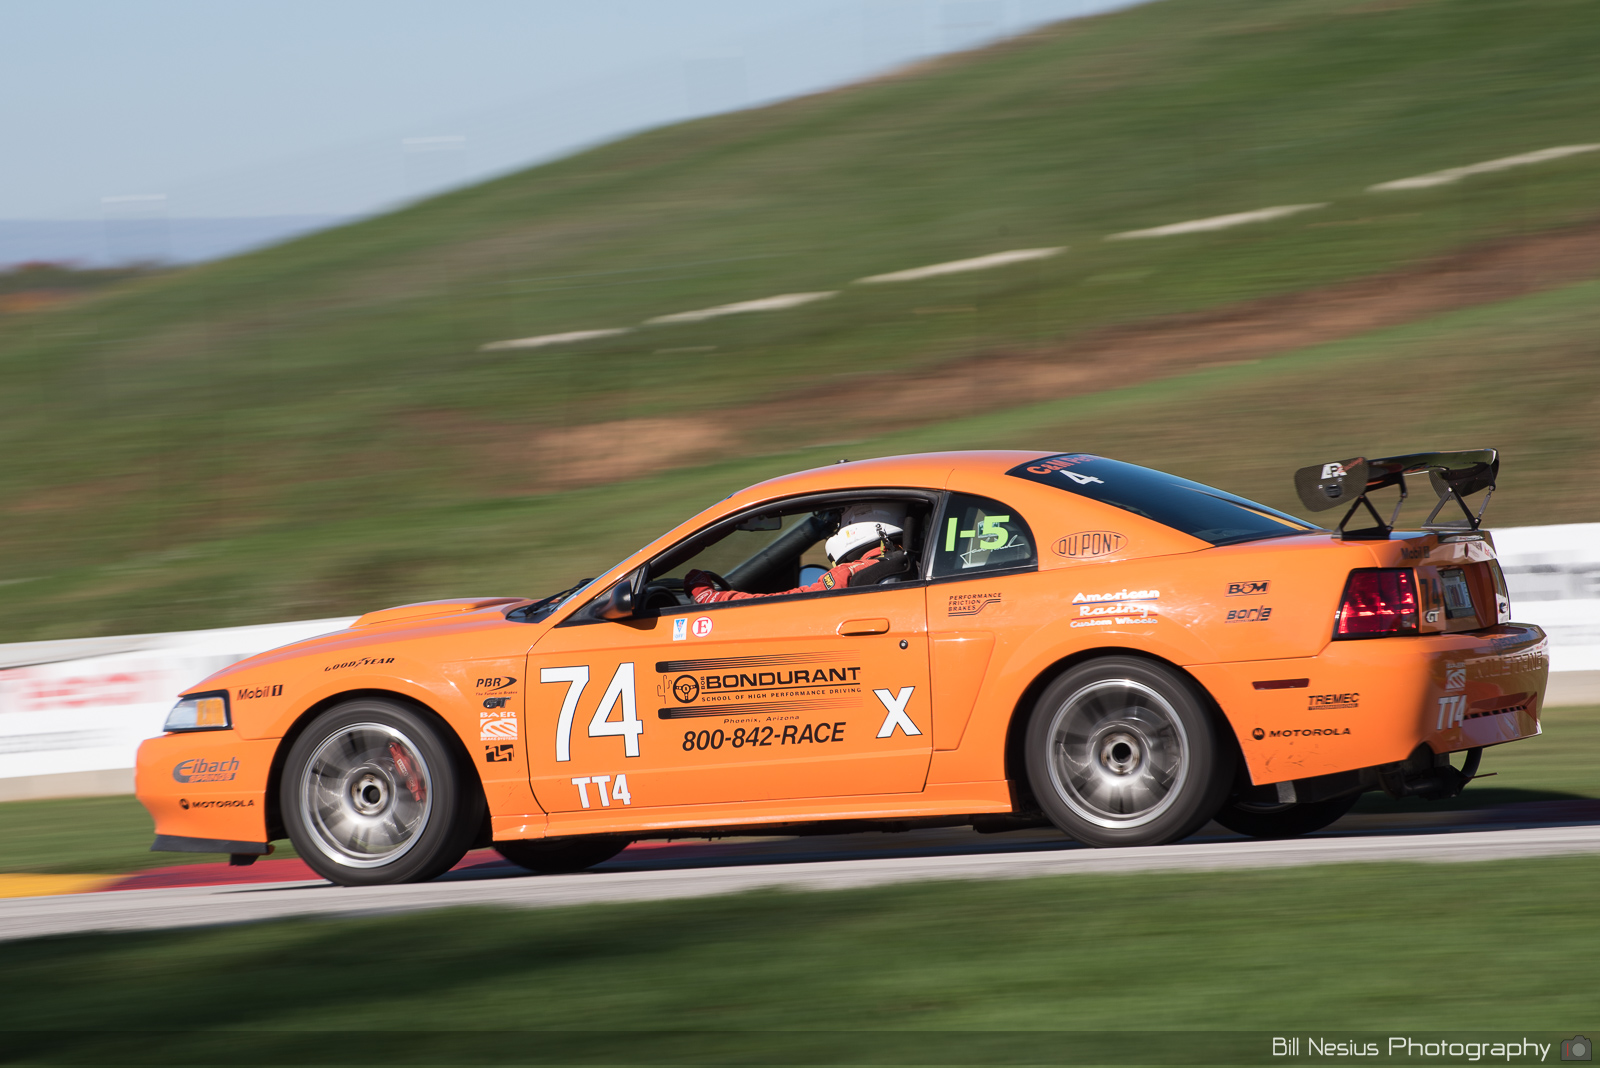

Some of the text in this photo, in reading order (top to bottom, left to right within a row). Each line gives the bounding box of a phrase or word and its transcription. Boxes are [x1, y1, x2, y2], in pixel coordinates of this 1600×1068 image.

[1060, 470, 1104, 485] 4
[1072, 589, 1160, 603] American
[1080, 603, 1148, 618] Racing
[1426, 611, 1440, 623] GT
[696, 620, 709, 634] E
[1070, 620, 1112, 628] Custom
[476, 677, 502, 687] PBR
[706, 667, 861, 689] BONDURANT
[237, 685, 283, 701] Mobil 1
[701, 693, 732, 702] SCHOOL
[770, 689, 826, 698] PERFORMANCE
[1308, 693, 1360, 705] TREMEC
[483, 697, 511, 709] GT
[540, 662, 643, 762] 74
[873, 686, 923, 739] X
[1437, 695, 1467, 730] TT4
[723, 714, 800, 725] Phoenix, Arizona
[682, 722, 847, 752] 800-842-RACE
[1269, 728, 1351, 737] MOTOROLA
[172, 756, 240, 783] Eibach
[571, 774, 631, 809] TT4
[192, 800, 255, 808] MOTOROLA
